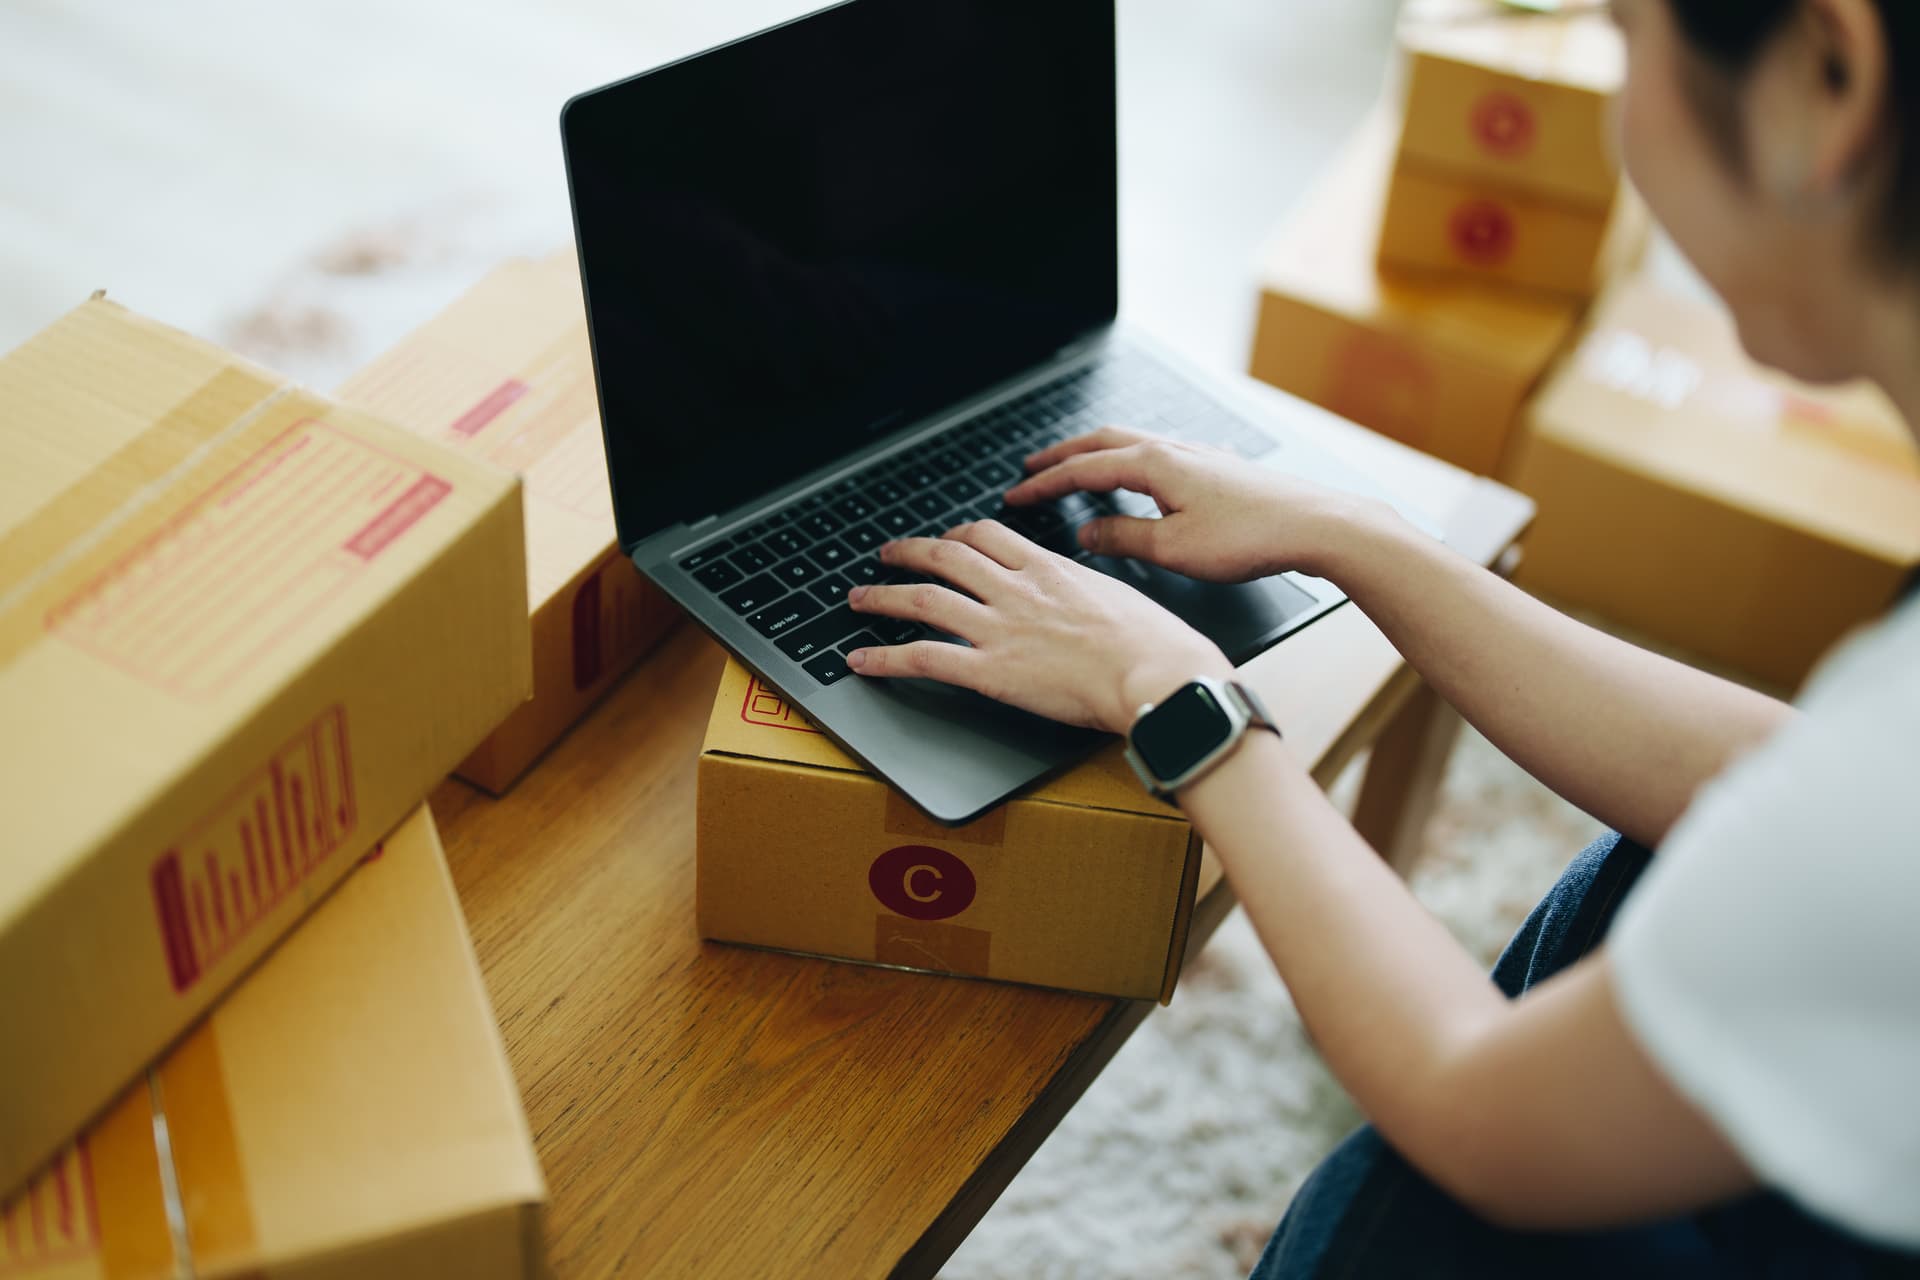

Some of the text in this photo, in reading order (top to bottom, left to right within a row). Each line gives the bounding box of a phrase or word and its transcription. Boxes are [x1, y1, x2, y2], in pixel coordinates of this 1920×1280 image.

[830, 585, 841, 594] A
[769, 613, 800, 631] caps lock
[797, 643, 814, 654] shift
[903, 864, 943, 903] C
